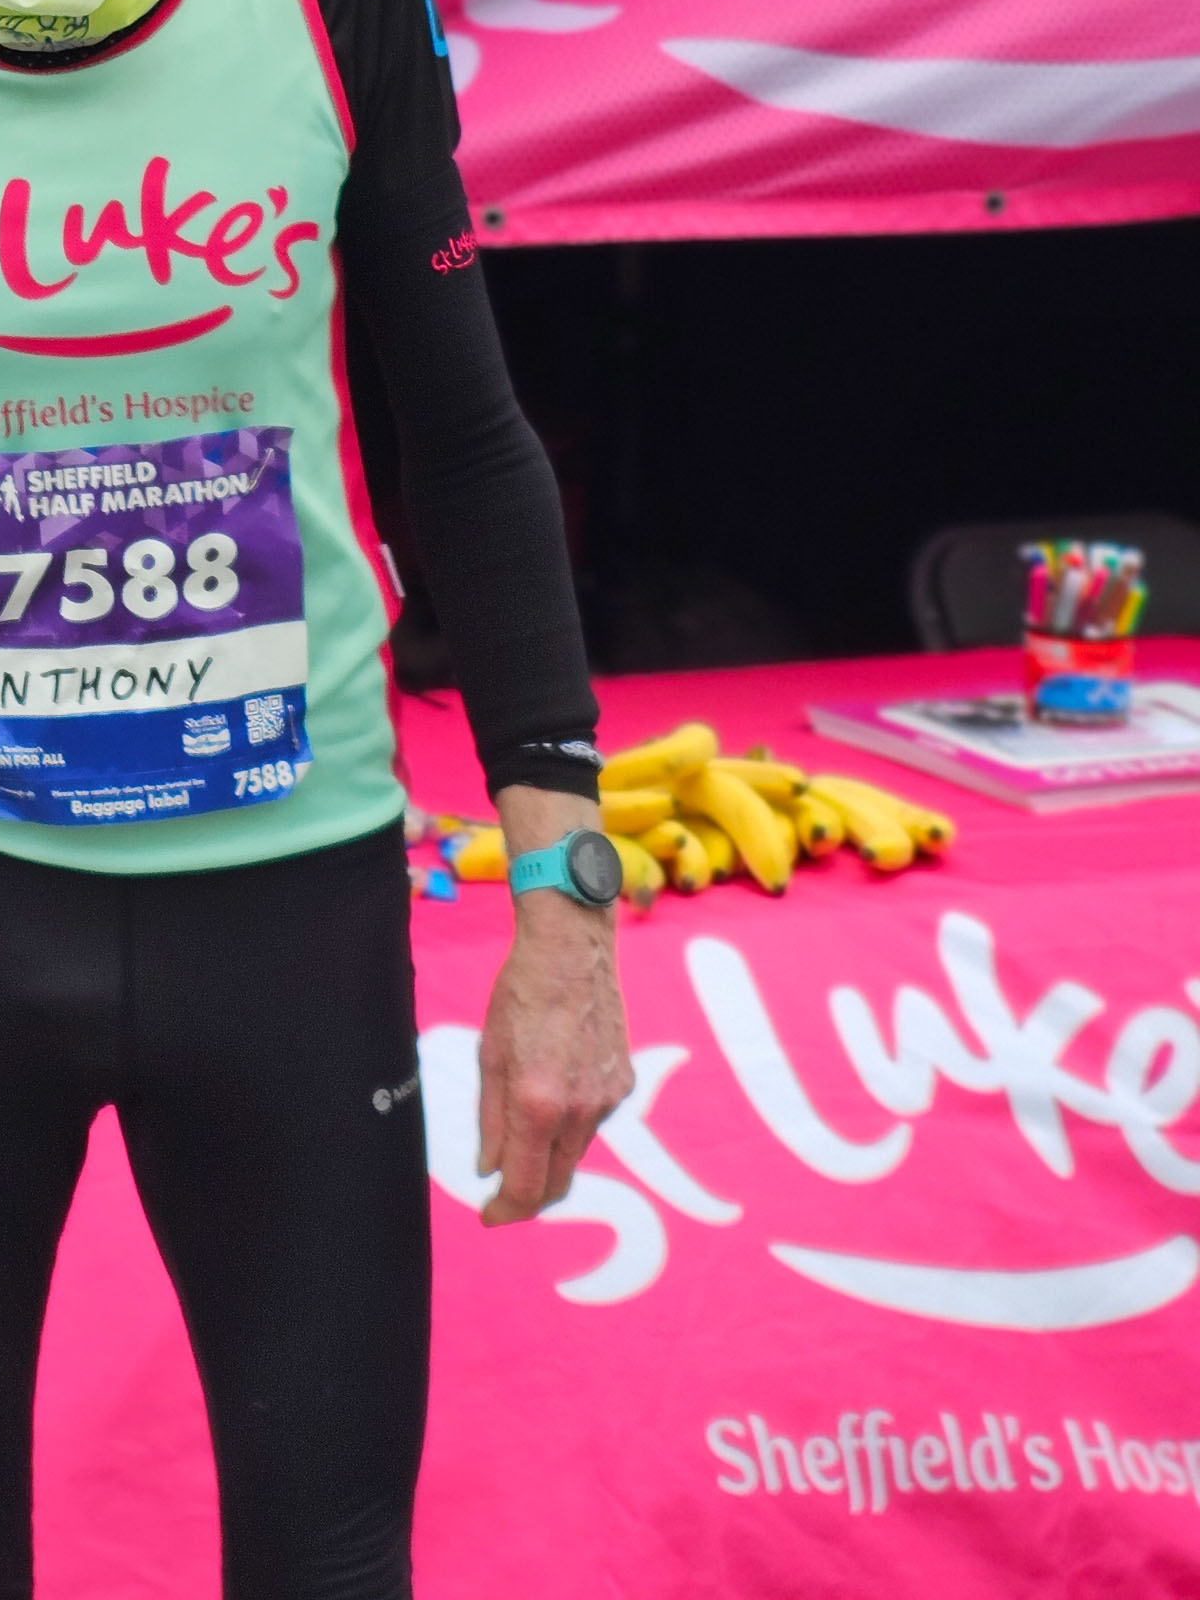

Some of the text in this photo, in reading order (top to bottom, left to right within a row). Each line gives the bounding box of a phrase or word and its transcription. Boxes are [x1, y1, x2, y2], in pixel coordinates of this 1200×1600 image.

[123, 386, 256, 424] Hospice
[26, 461, 158, 495] SHEFFIELD
[28, 472, 252, 519] HALF MARATHON
[13, 752, 41, 768] FOR
[42, 752, 67, 767] ALL
[232, 760, 295, 798] 7588
[70, 789, 190, 817] Baggage label
[704, 1408, 1063, 1515] Sheffield's
